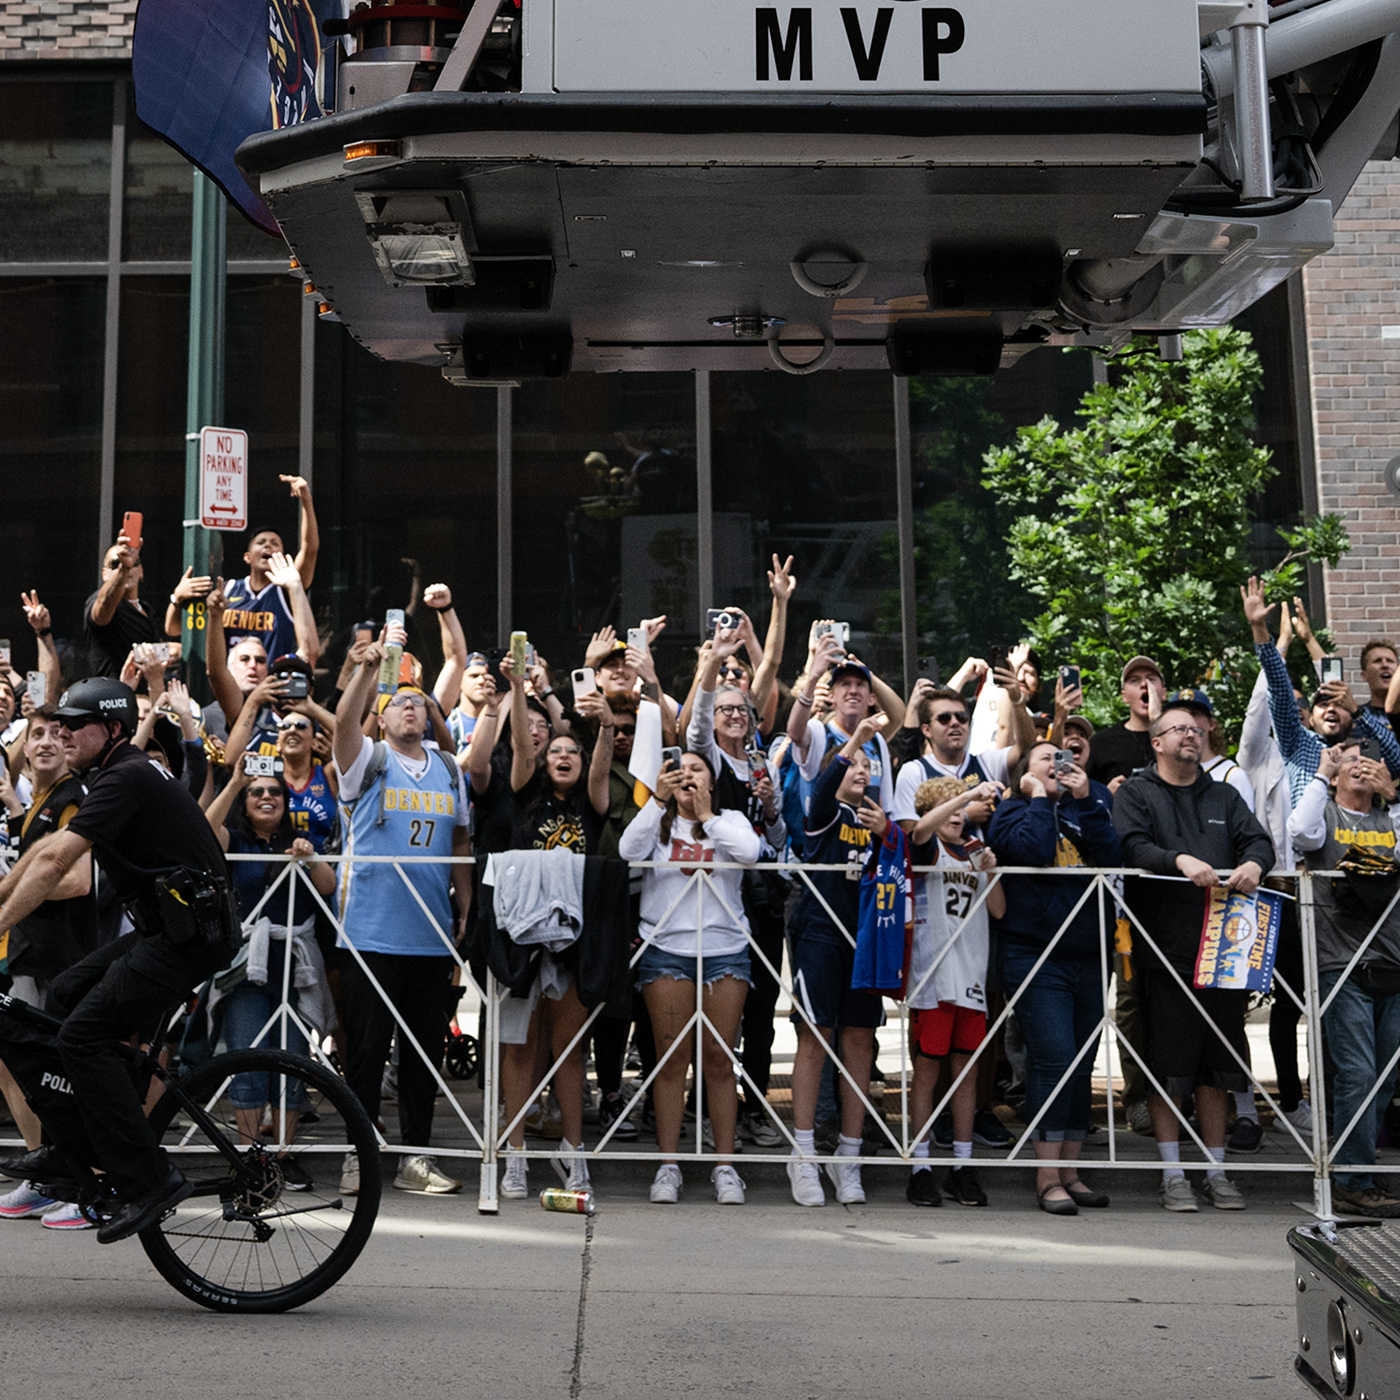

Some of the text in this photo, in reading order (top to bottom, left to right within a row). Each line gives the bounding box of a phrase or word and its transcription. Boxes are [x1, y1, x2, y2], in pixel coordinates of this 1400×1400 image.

[755, 8, 966, 81] MVP
[217, 435, 233, 453] NO
[206, 454, 243, 474] PARKING
[216, 475, 233, 487] ANY
[215, 489, 233, 501] TIME
[187, 602, 206, 615] 40
[186, 616, 205, 629] 60
[222, 609, 275, 631] DENVER
[99, 698, 128, 710] POLICE
[385, 788, 455, 816] DENVER
[409, 819, 436, 848] 27
[945, 888, 973, 919] 27
[876, 914, 897, 929] ITY
[1198, 886, 1229, 986] HAMPIONS
